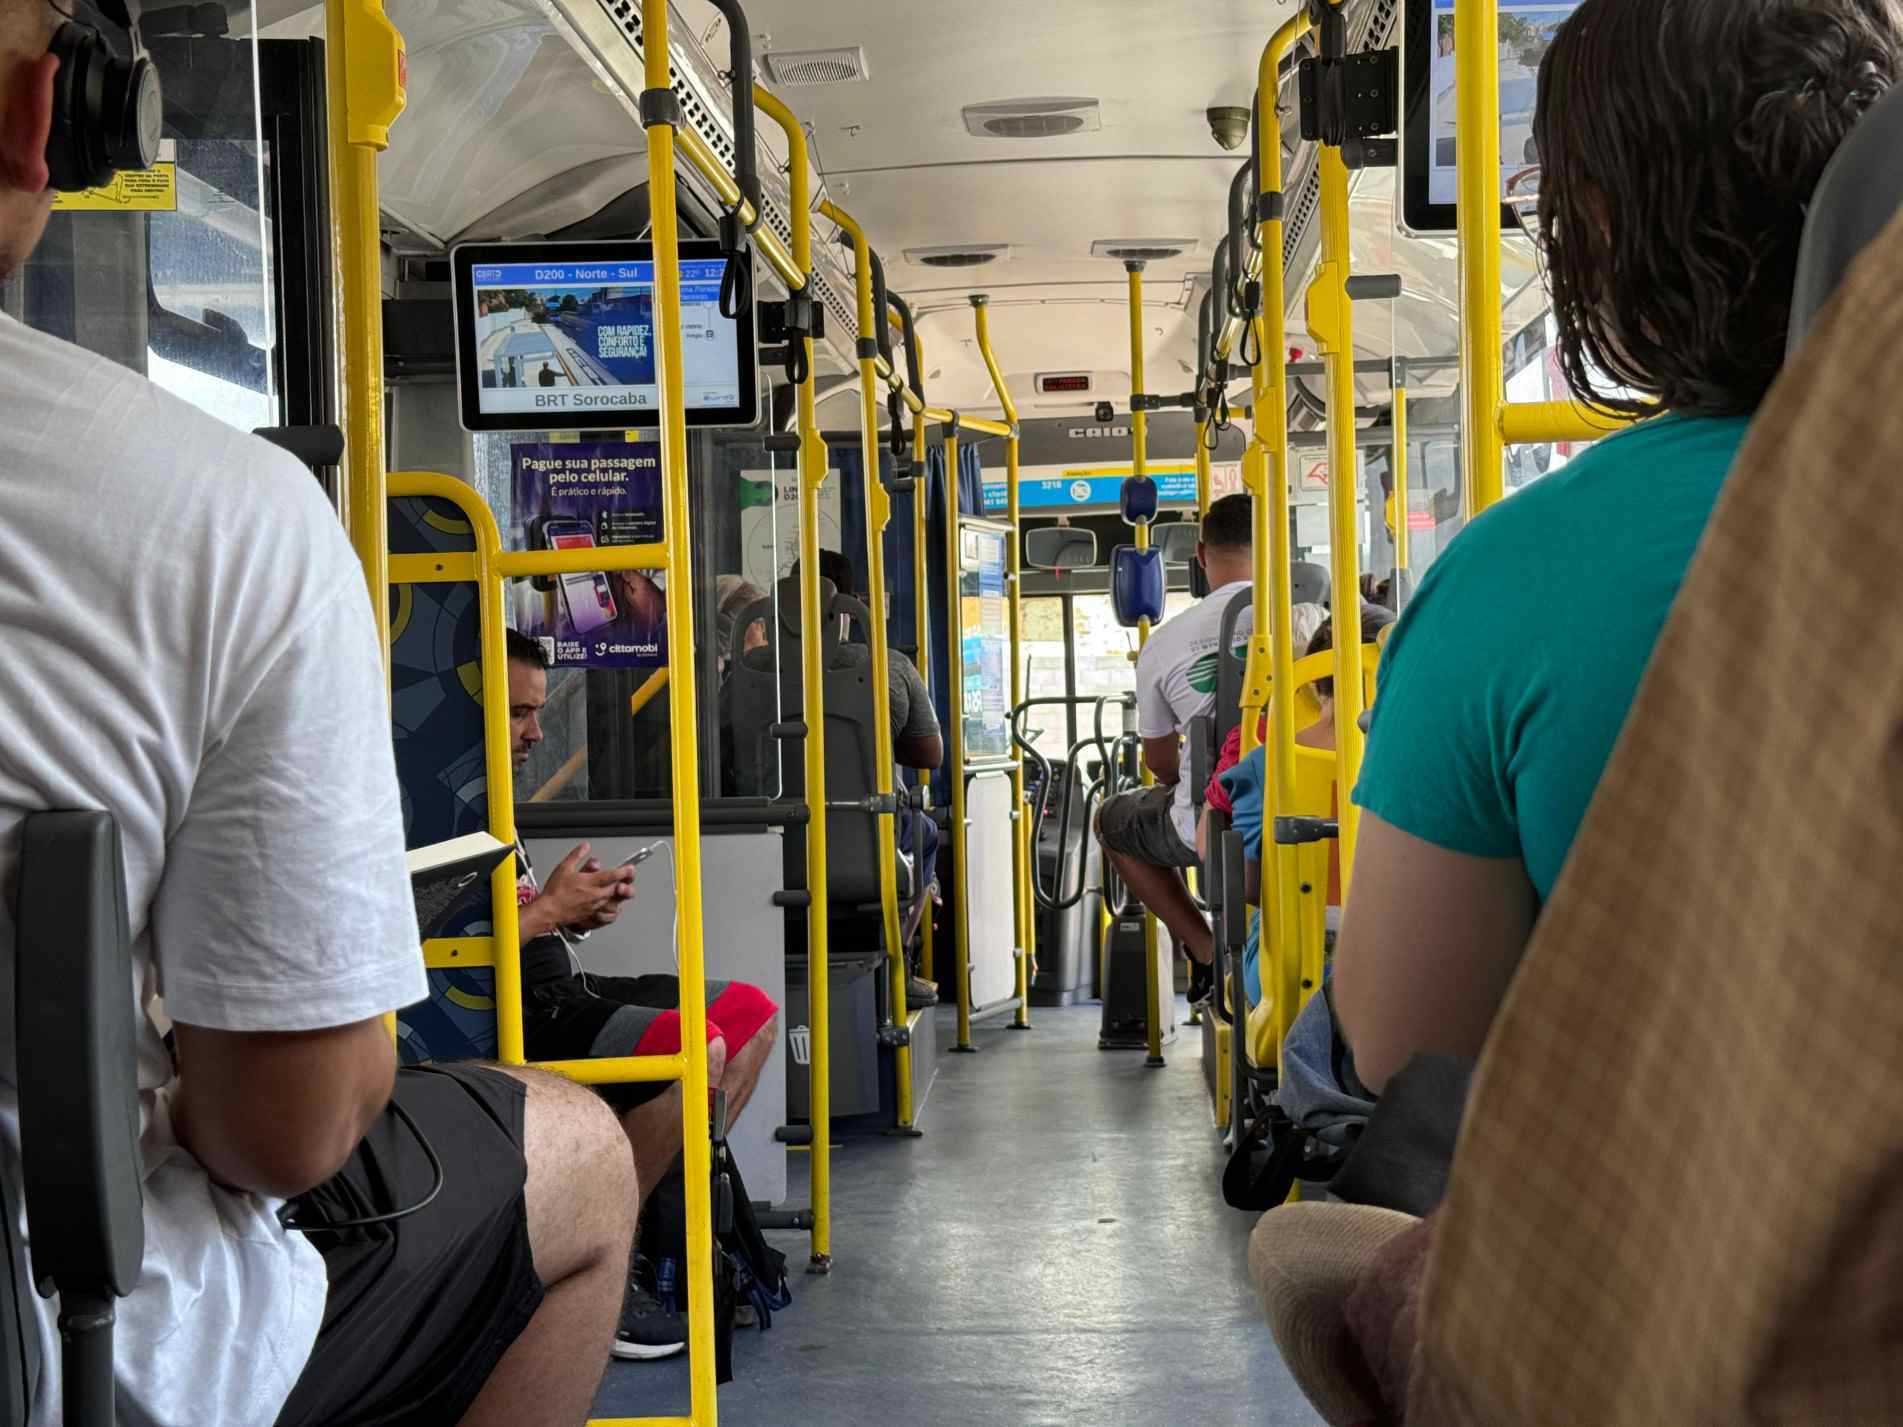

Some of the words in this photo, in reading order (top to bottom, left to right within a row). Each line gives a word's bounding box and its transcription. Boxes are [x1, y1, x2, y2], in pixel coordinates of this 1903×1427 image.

[535, 269, 565, 280] D200
[575, 268, 608, 279] Norte
[618, 267, 638, 278] Sul
[598, 325, 615, 336] COM
[598, 336, 639, 346] CONFORTO
[535, 394, 568, 407] BRT
[573, 391, 648, 406] Sorocaba
[522, 457, 563, 471] Pague
[565, 459, 588, 469] sua
[591, 457, 656, 471] passagem
[549, 470, 578, 484] pelo
[580, 470, 629, 482] celular.
[551, 486, 558, 496] É
[558, 486, 589, 497] prático
[590, 488, 597, 496] e
[597, 486, 628, 497] rápido.
[608, 643, 658, 653] cittamobi
